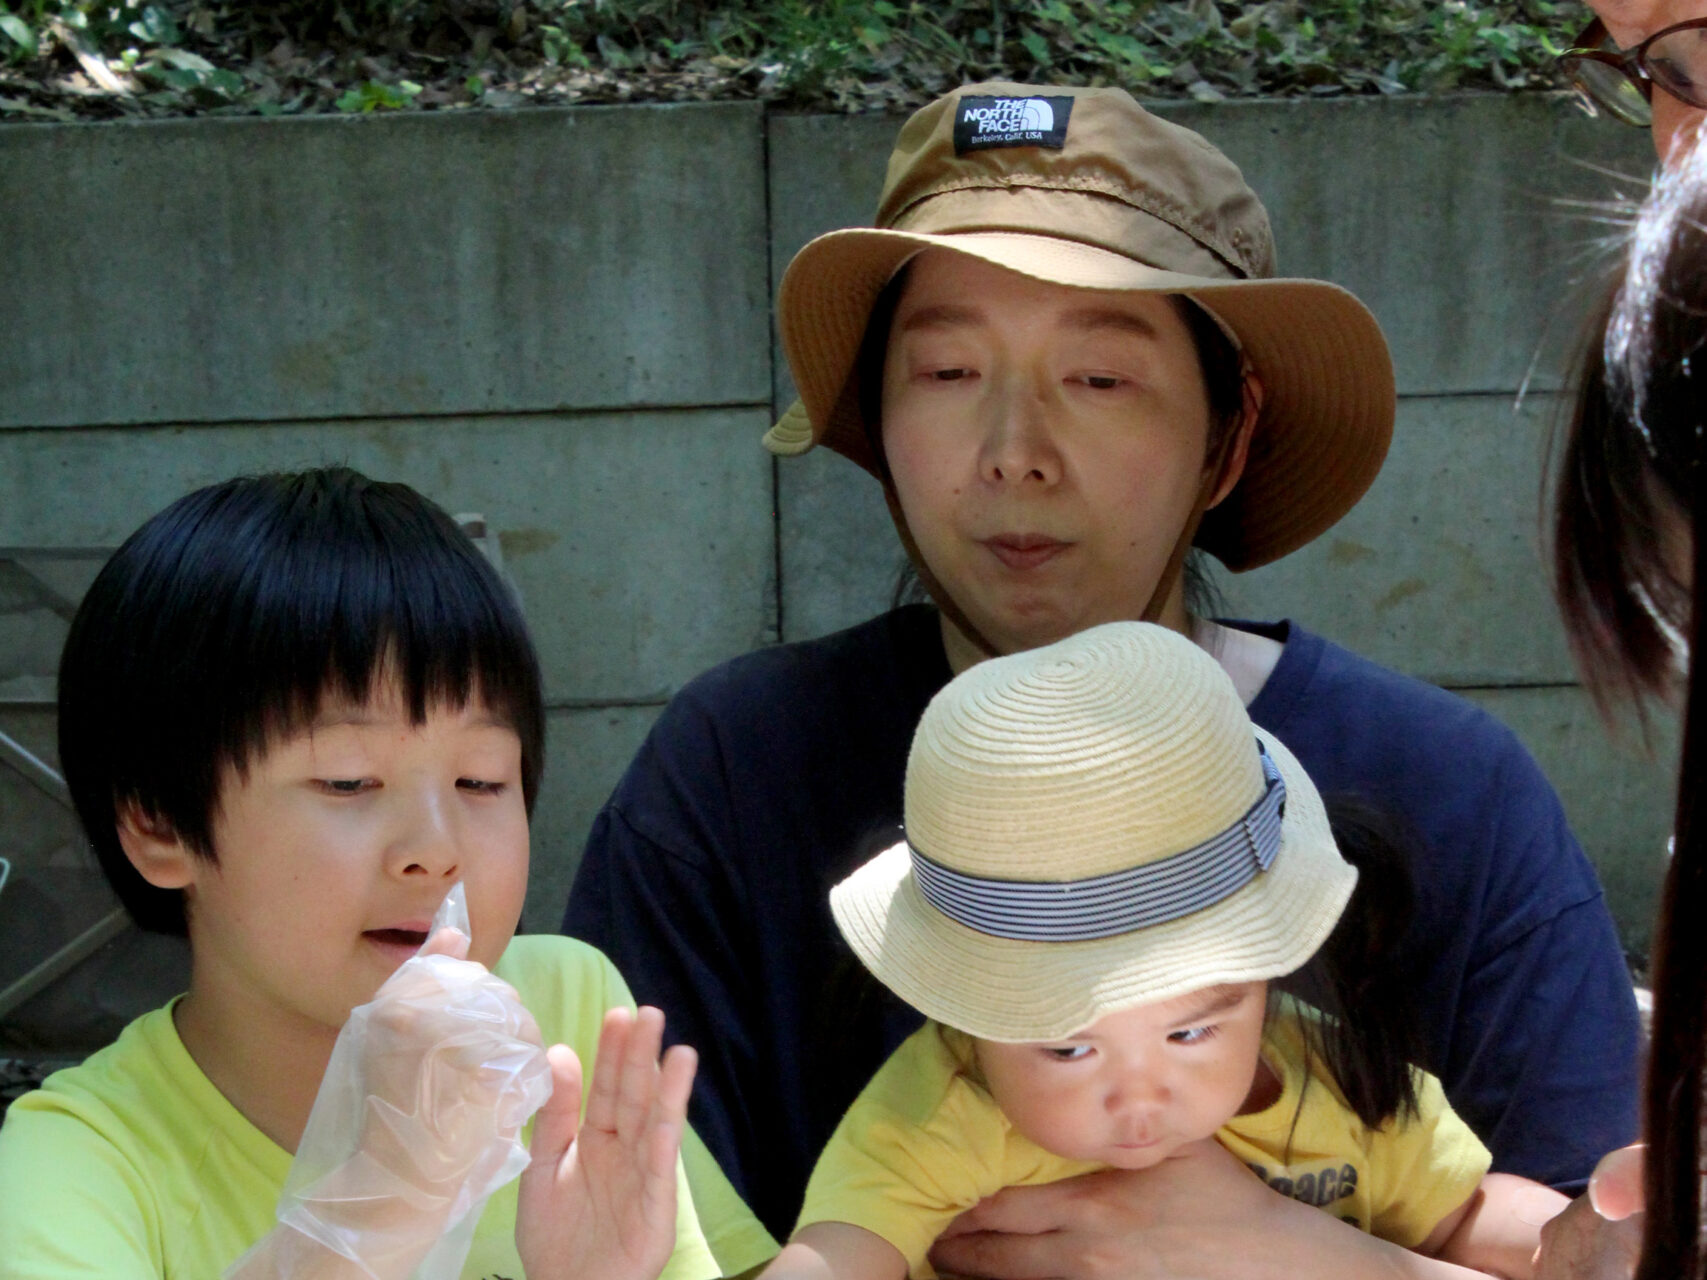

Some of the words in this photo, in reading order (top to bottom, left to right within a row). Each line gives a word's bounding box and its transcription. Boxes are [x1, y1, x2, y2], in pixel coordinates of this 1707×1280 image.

[995, 99, 1026, 109] THE
[964, 108, 1023, 122] NORTH
[978, 119, 1020, 133] FACE
[1025, 131, 1043, 140] USA
